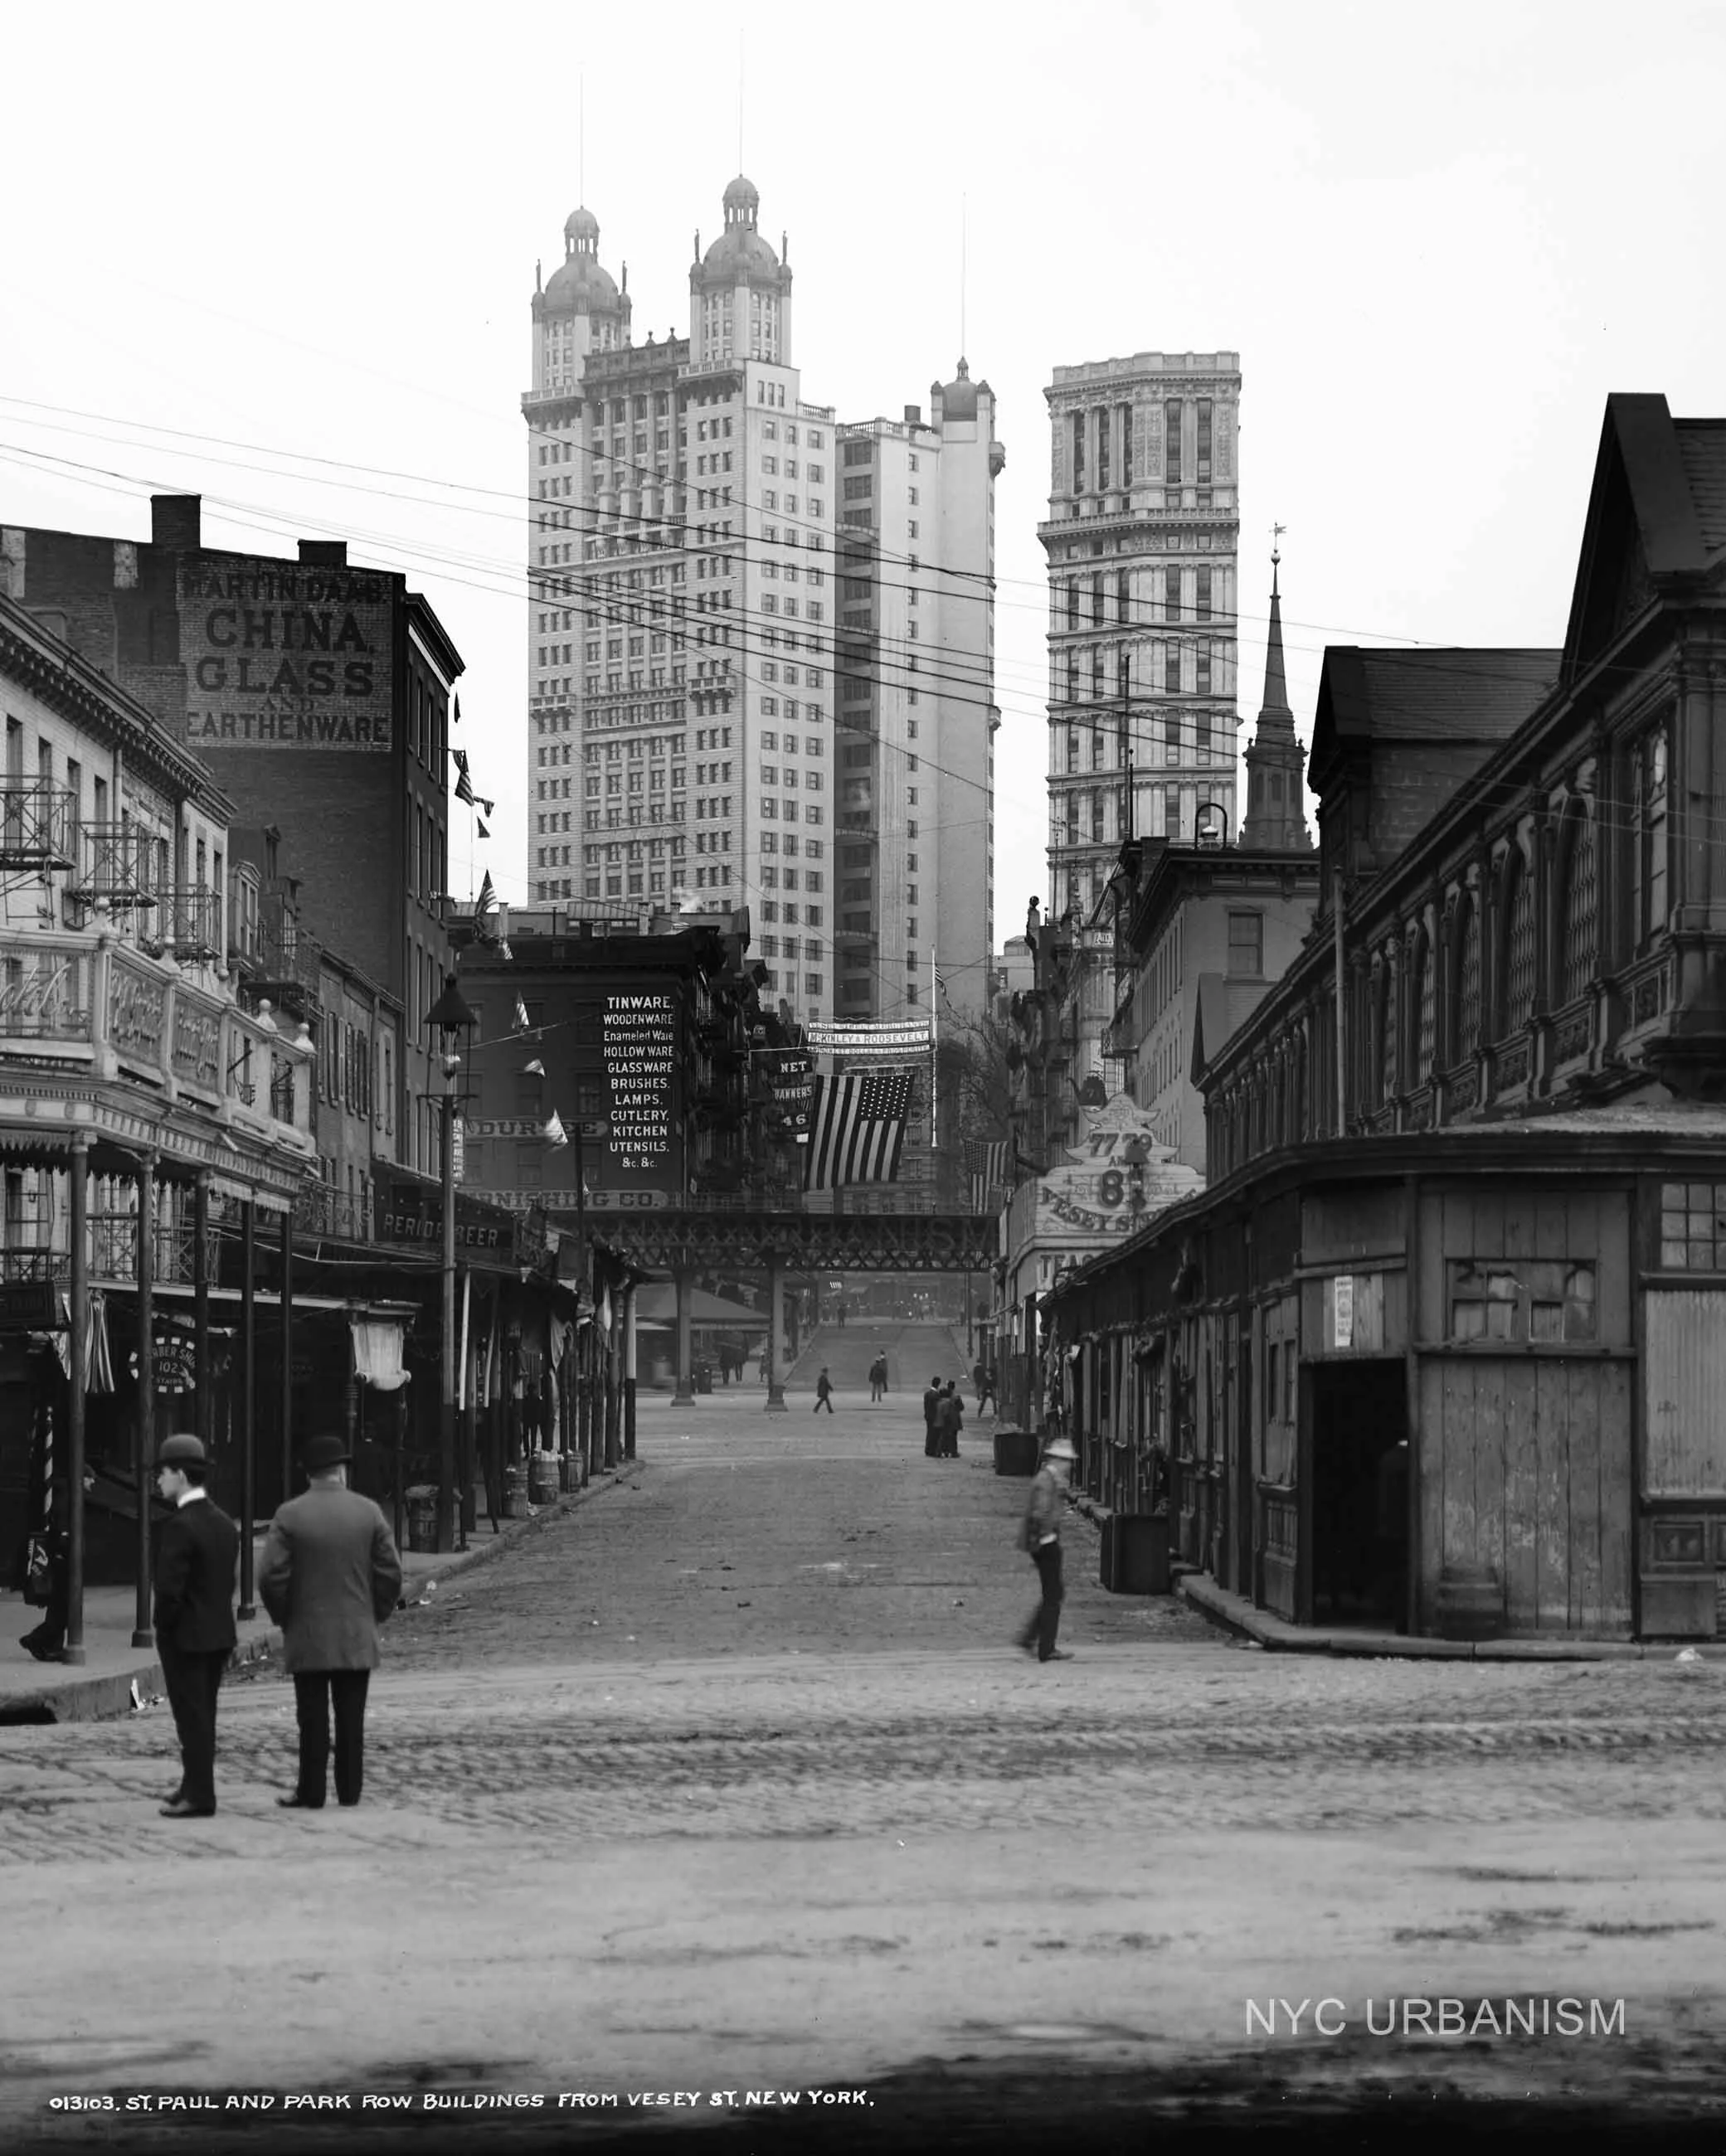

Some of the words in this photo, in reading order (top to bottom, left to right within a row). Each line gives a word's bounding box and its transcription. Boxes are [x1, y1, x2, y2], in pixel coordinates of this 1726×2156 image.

[197, 656, 373, 697] GLASS
[258, 696, 314, 713] AND
[186, 711, 391, 742] EARTHENWARE
[606, 997, 674, 1009] TINWARE.
[603, 1014, 673, 1026] WOODENWARE
[604, 1030, 650, 1042] Enameled
[604, 1046, 645, 1057] HOLLOW
[647, 1046, 673, 1056] WARE
[607, 1061, 673, 1073] GLASSWARE
[780, 1061, 807, 1073] NET
[610, 1078, 670, 1090] BRUSHES.
[615, 1095, 664, 1105] LAMPS.
[478, 1121, 598, 1135] DUREE
[613, 1125, 668, 1137] KITCHEN
[610, 1142, 669, 1153] UTENSILS.
[1089, 1134, 1119, 1158] 77
[1108, 1155, 1126, 1167] AN
[471, 1192, 609, 1207] RNISHIG
[620, 1192, 659, 1207] CO.
[1041, 1187, 1114, 1231] VESEY
[149, 1347, 177, 1360] ARBER
